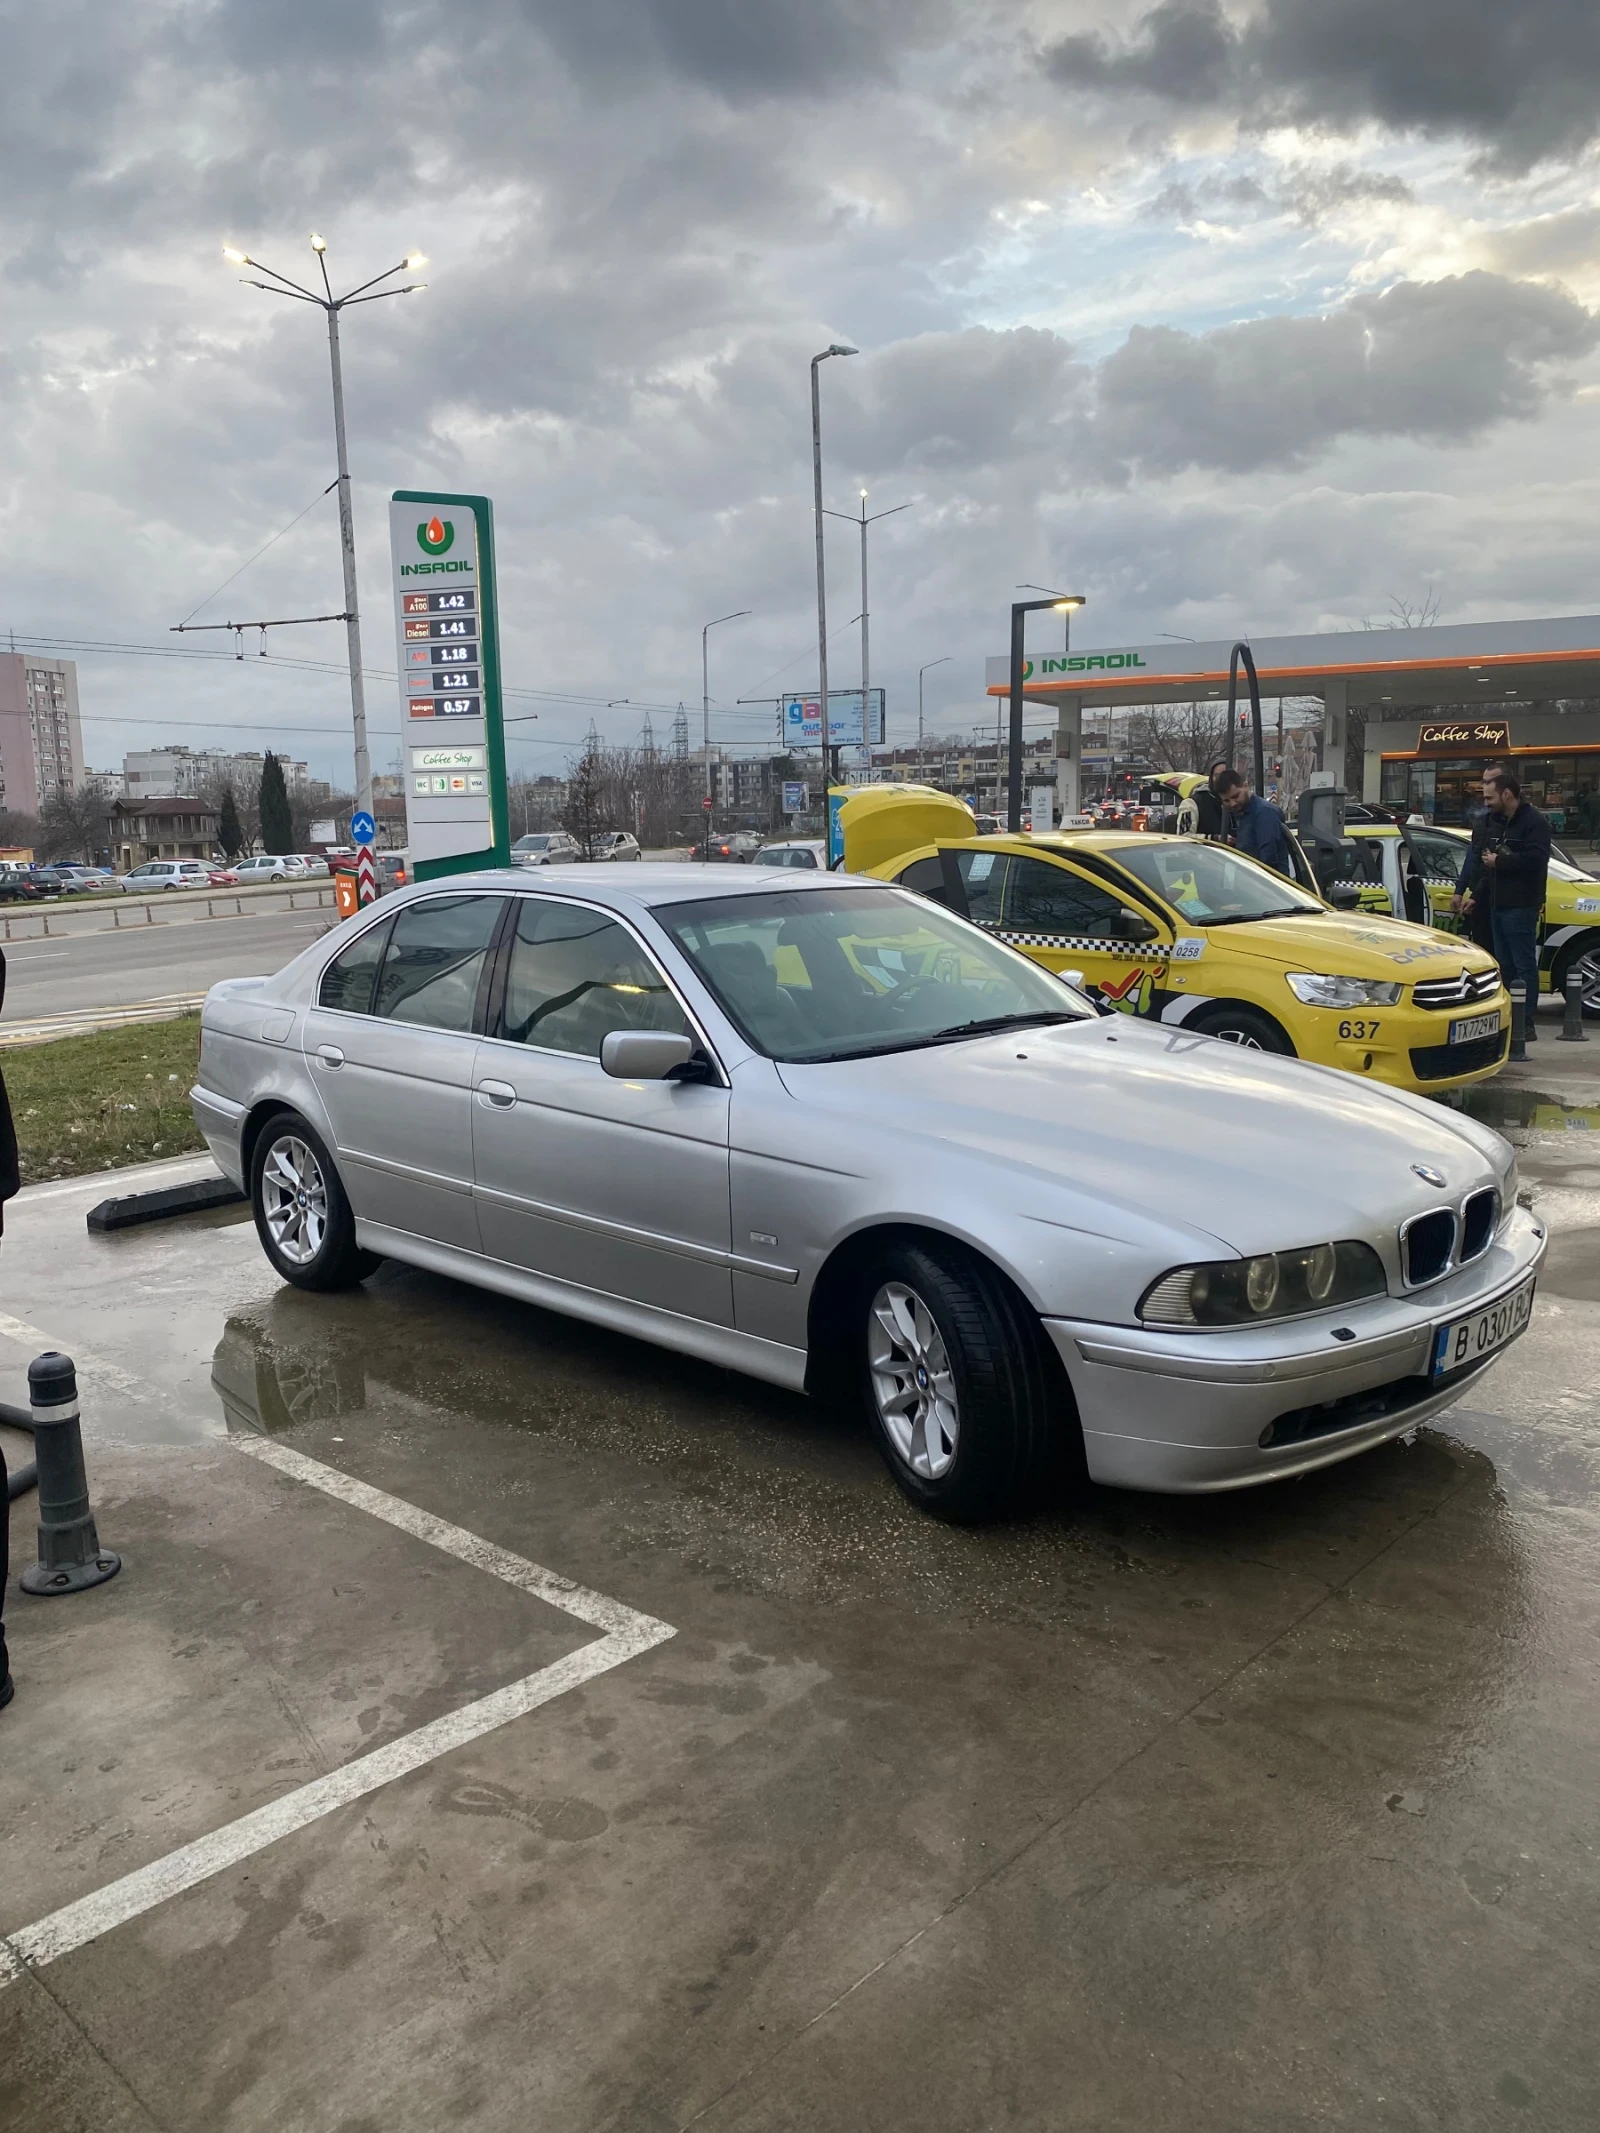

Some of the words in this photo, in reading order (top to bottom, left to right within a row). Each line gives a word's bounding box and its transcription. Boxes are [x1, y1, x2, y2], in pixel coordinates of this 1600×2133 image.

[401, 560, 474, 576] INSAOIL
[409, 603, 428, 611] A100
[438, 595, 465, 609] 1.42
[407, 629, 429, 638] Diesel
[440, 621, 466, 635] 1.41
[441, 647, 468, 661] 1.18
[1041, 653, 1147, 673] INSAOIL
[442, 674, 469, 687] 1.21
[443, 699, 470, 713] 0.57
[801, 722, 846, 731] outoor
[803, 729, 837, 737] mea
[1423, 726, 1470, 742] Coffee
[1474, 725, 1505, 745] Shop
[423, 754, 451, 765] Coffee
[454, 753, 473, 766] Shop
[1577, 903, 1598, 912] 2191
[1176, 946, 1200, 958] 0258
[1338, 1019, 1381, 1040] 637
